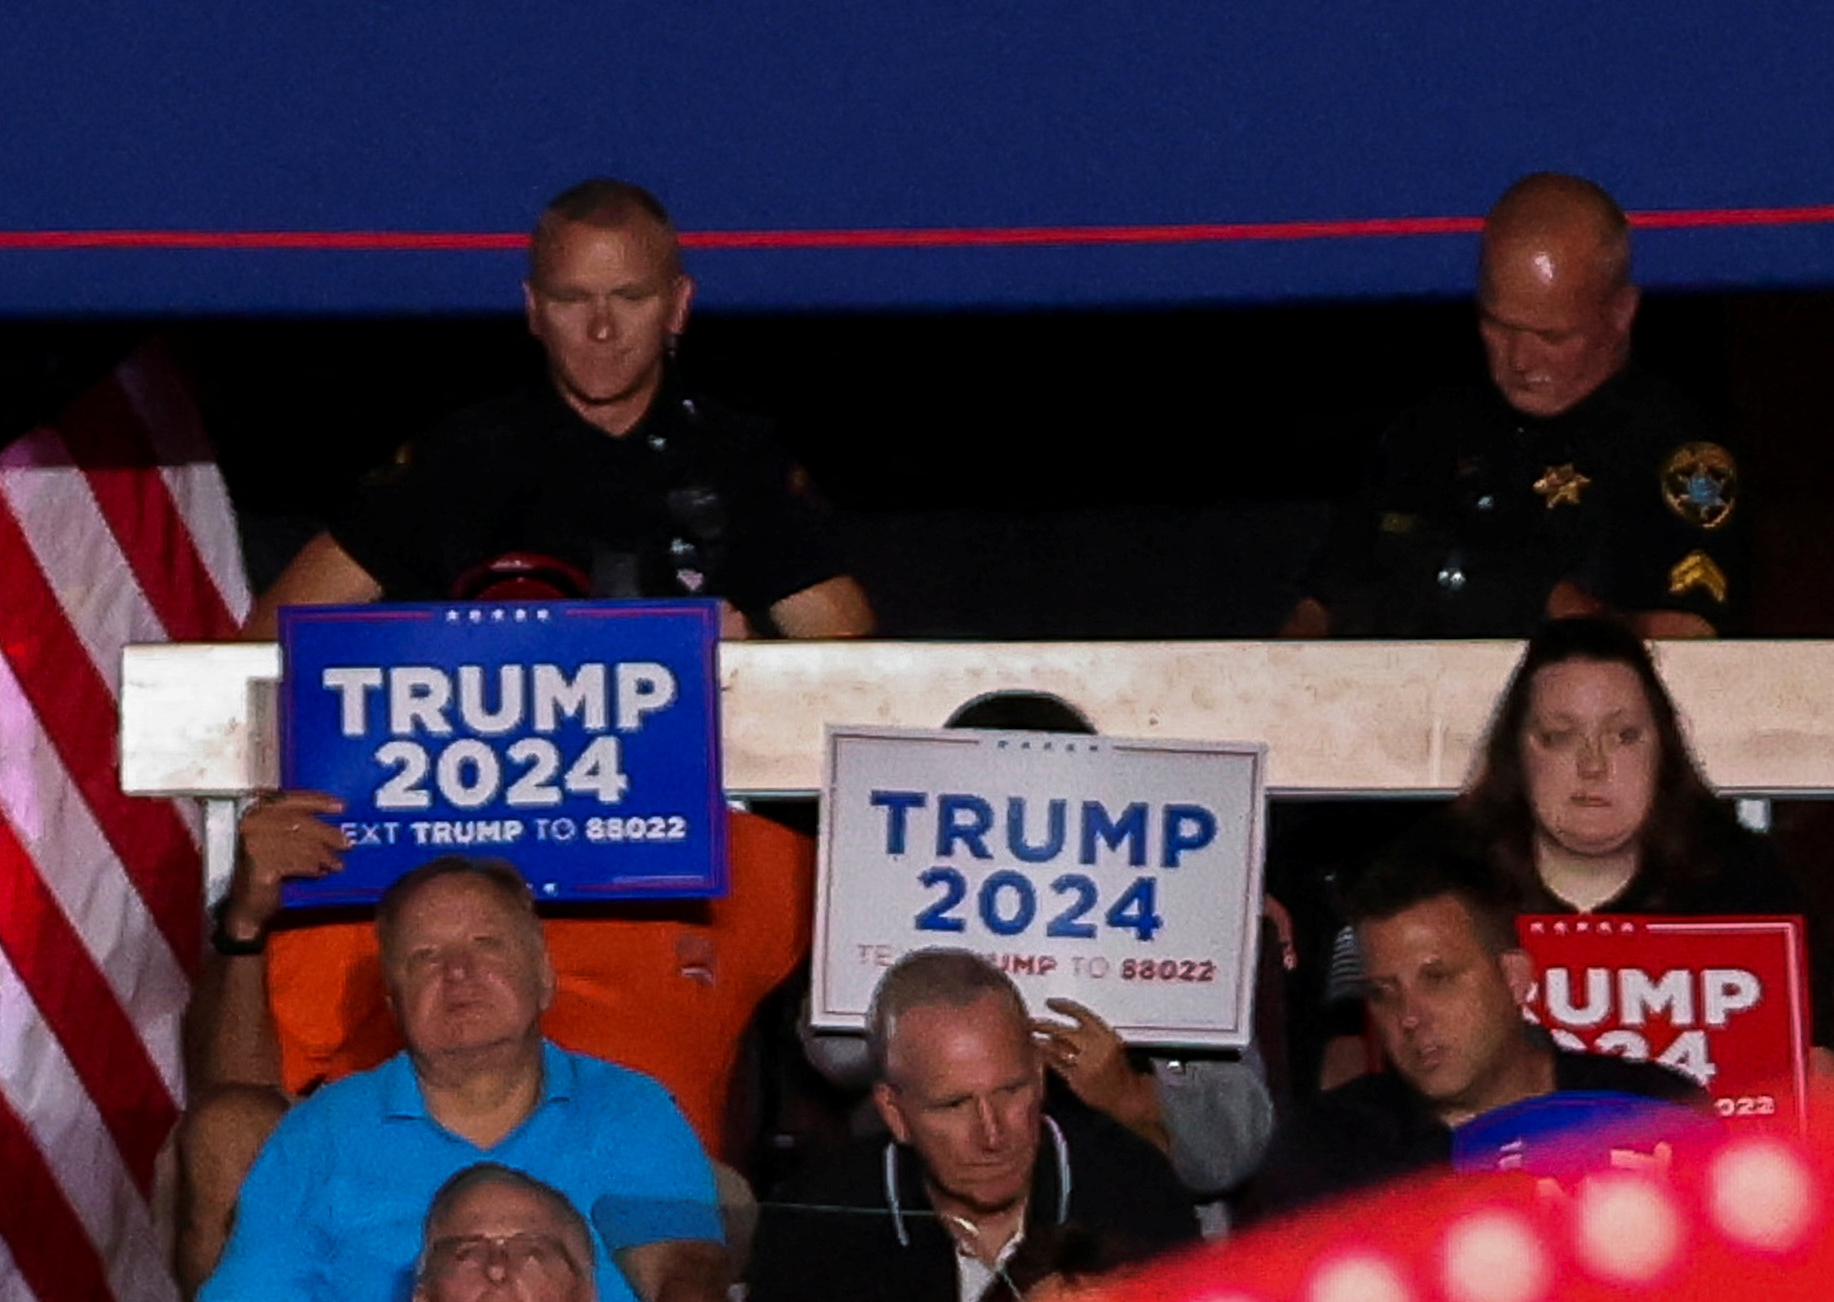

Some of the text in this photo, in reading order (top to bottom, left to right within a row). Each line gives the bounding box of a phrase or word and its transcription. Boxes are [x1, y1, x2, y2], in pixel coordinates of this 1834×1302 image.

[322, 662, 676, 736] TRUMP
[374, 735, 629, 809] 2024
[341, 815, 687, 847] EXT TRUMP TO 88022
[870, 790, 1217, 868] TRUMP
[914, 865, 1164, 942] 2024
[856, 943, 893, 967] TE
[1071, 955, 1110, 980] TO
[1120, 958, 1218, 983] 88022
[1523, 966, 1762, 1027] UMP
[1714, 1095, 1775, 1117] 022
